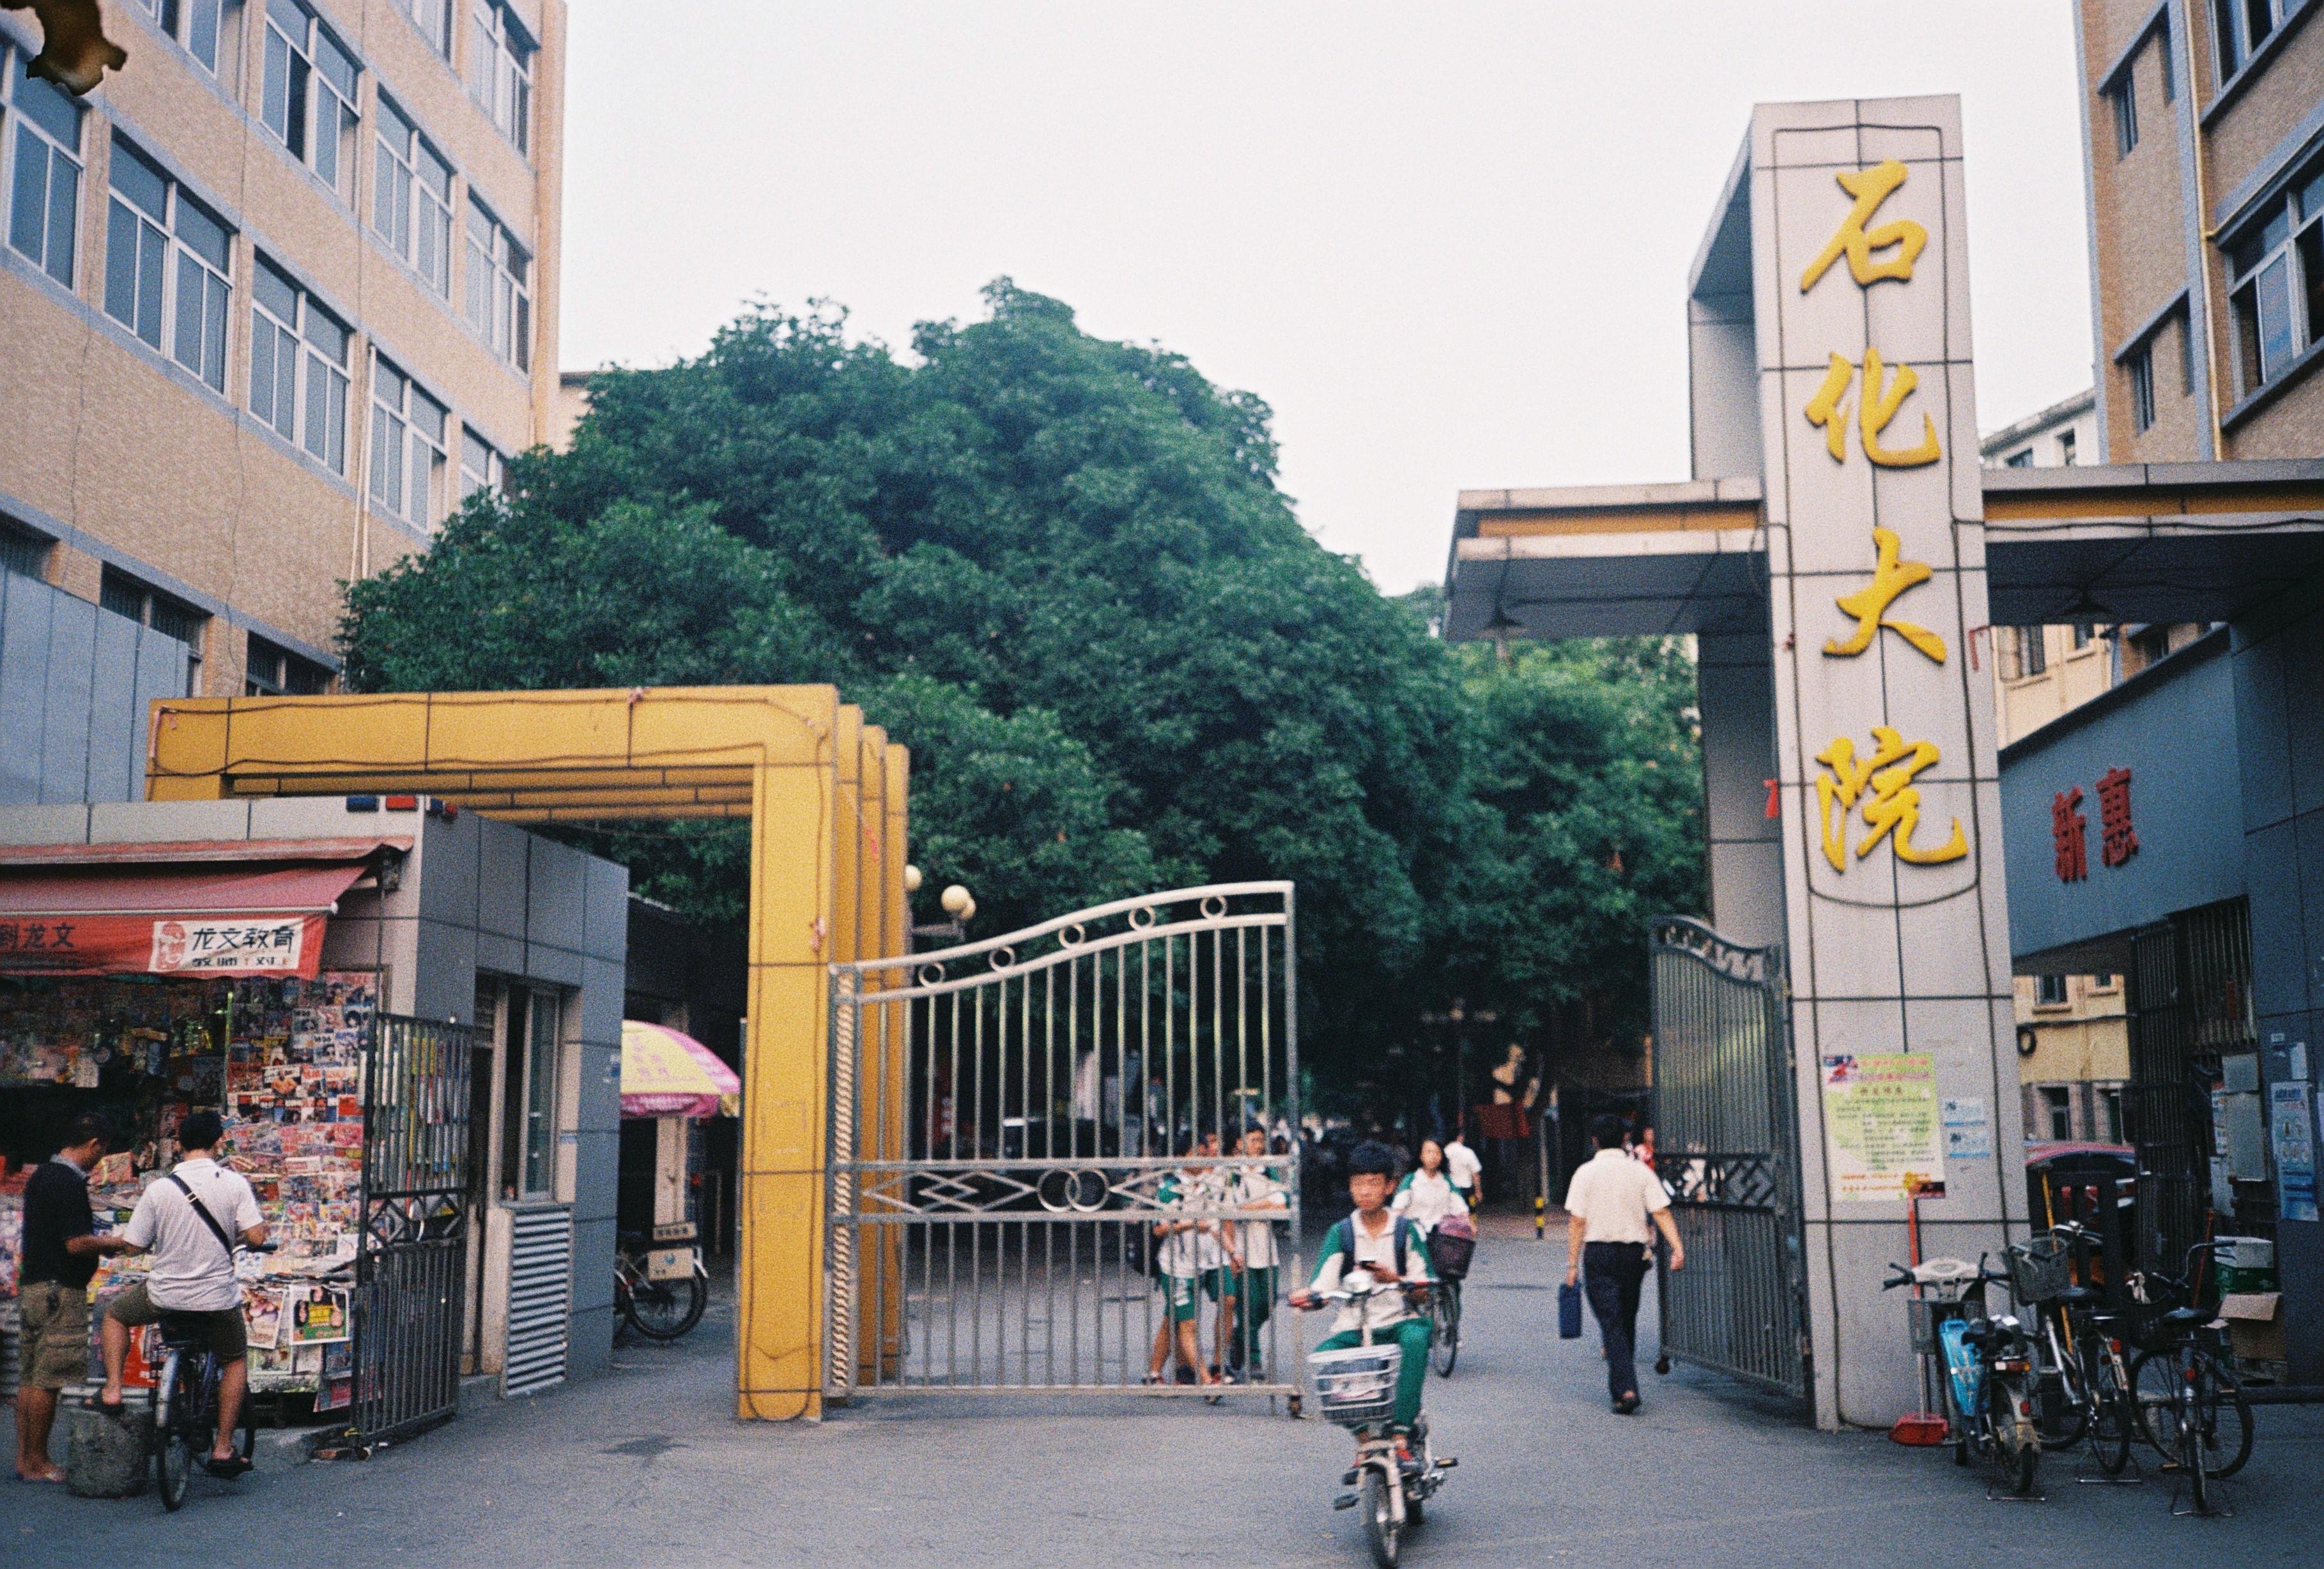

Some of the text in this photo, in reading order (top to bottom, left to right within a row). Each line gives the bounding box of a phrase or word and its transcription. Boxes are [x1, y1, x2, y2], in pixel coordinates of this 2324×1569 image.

[1801, 158, 1968, 871] 石化大院
[192, 925, 295, 954] 龙文教育
